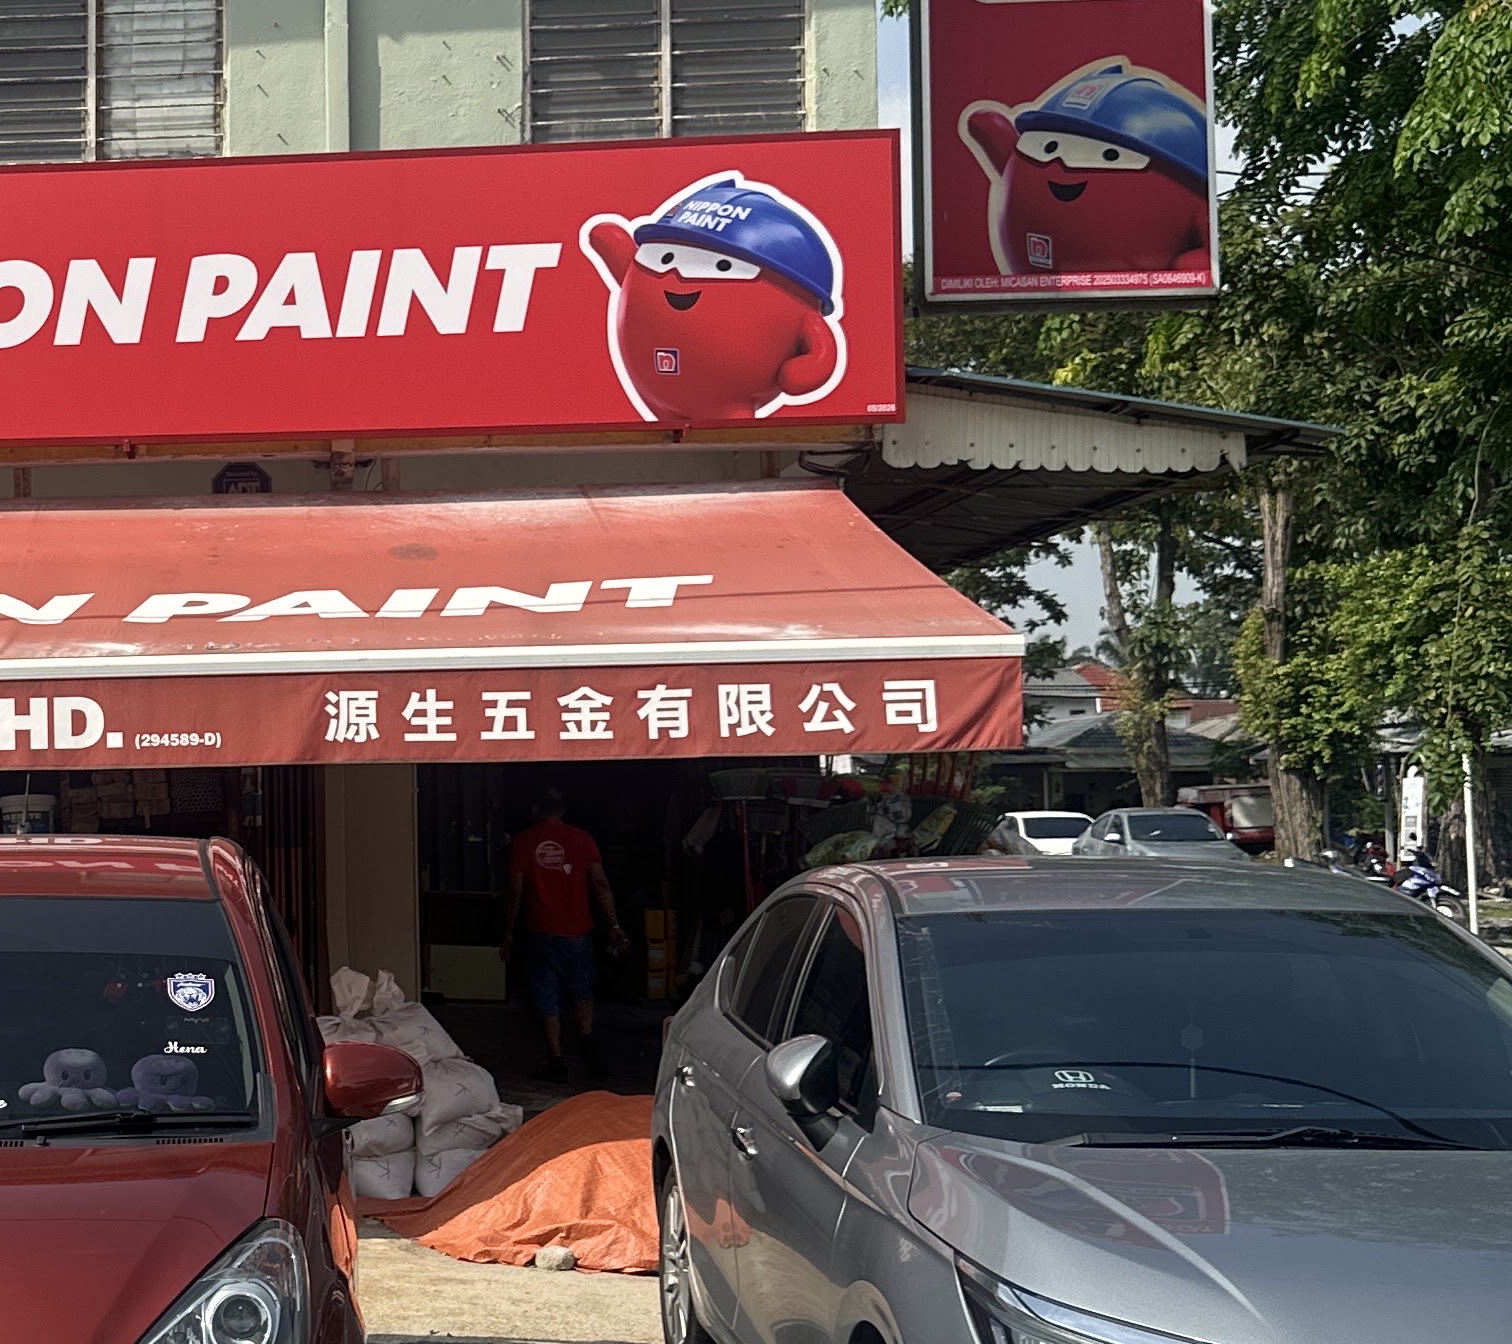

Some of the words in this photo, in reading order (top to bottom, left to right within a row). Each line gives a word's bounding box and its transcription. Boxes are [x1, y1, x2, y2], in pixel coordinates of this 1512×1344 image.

[682, 200, 753, 221] NIPPON
[677, 211, 733, 232] PAINT
[1000, 276, 1038, 288] MICASAN
[1039, 274, 1092, 288] ENTERPRISE
[175, 242, 563, 343] PAINT
[123, 574, 714, 624] PAINT
[324, 679, 938, 743] 源生五金有限公司
[134, 731, 222, 750] (294589-D)
[1051, 1082, 1112, 1091] HONDA
